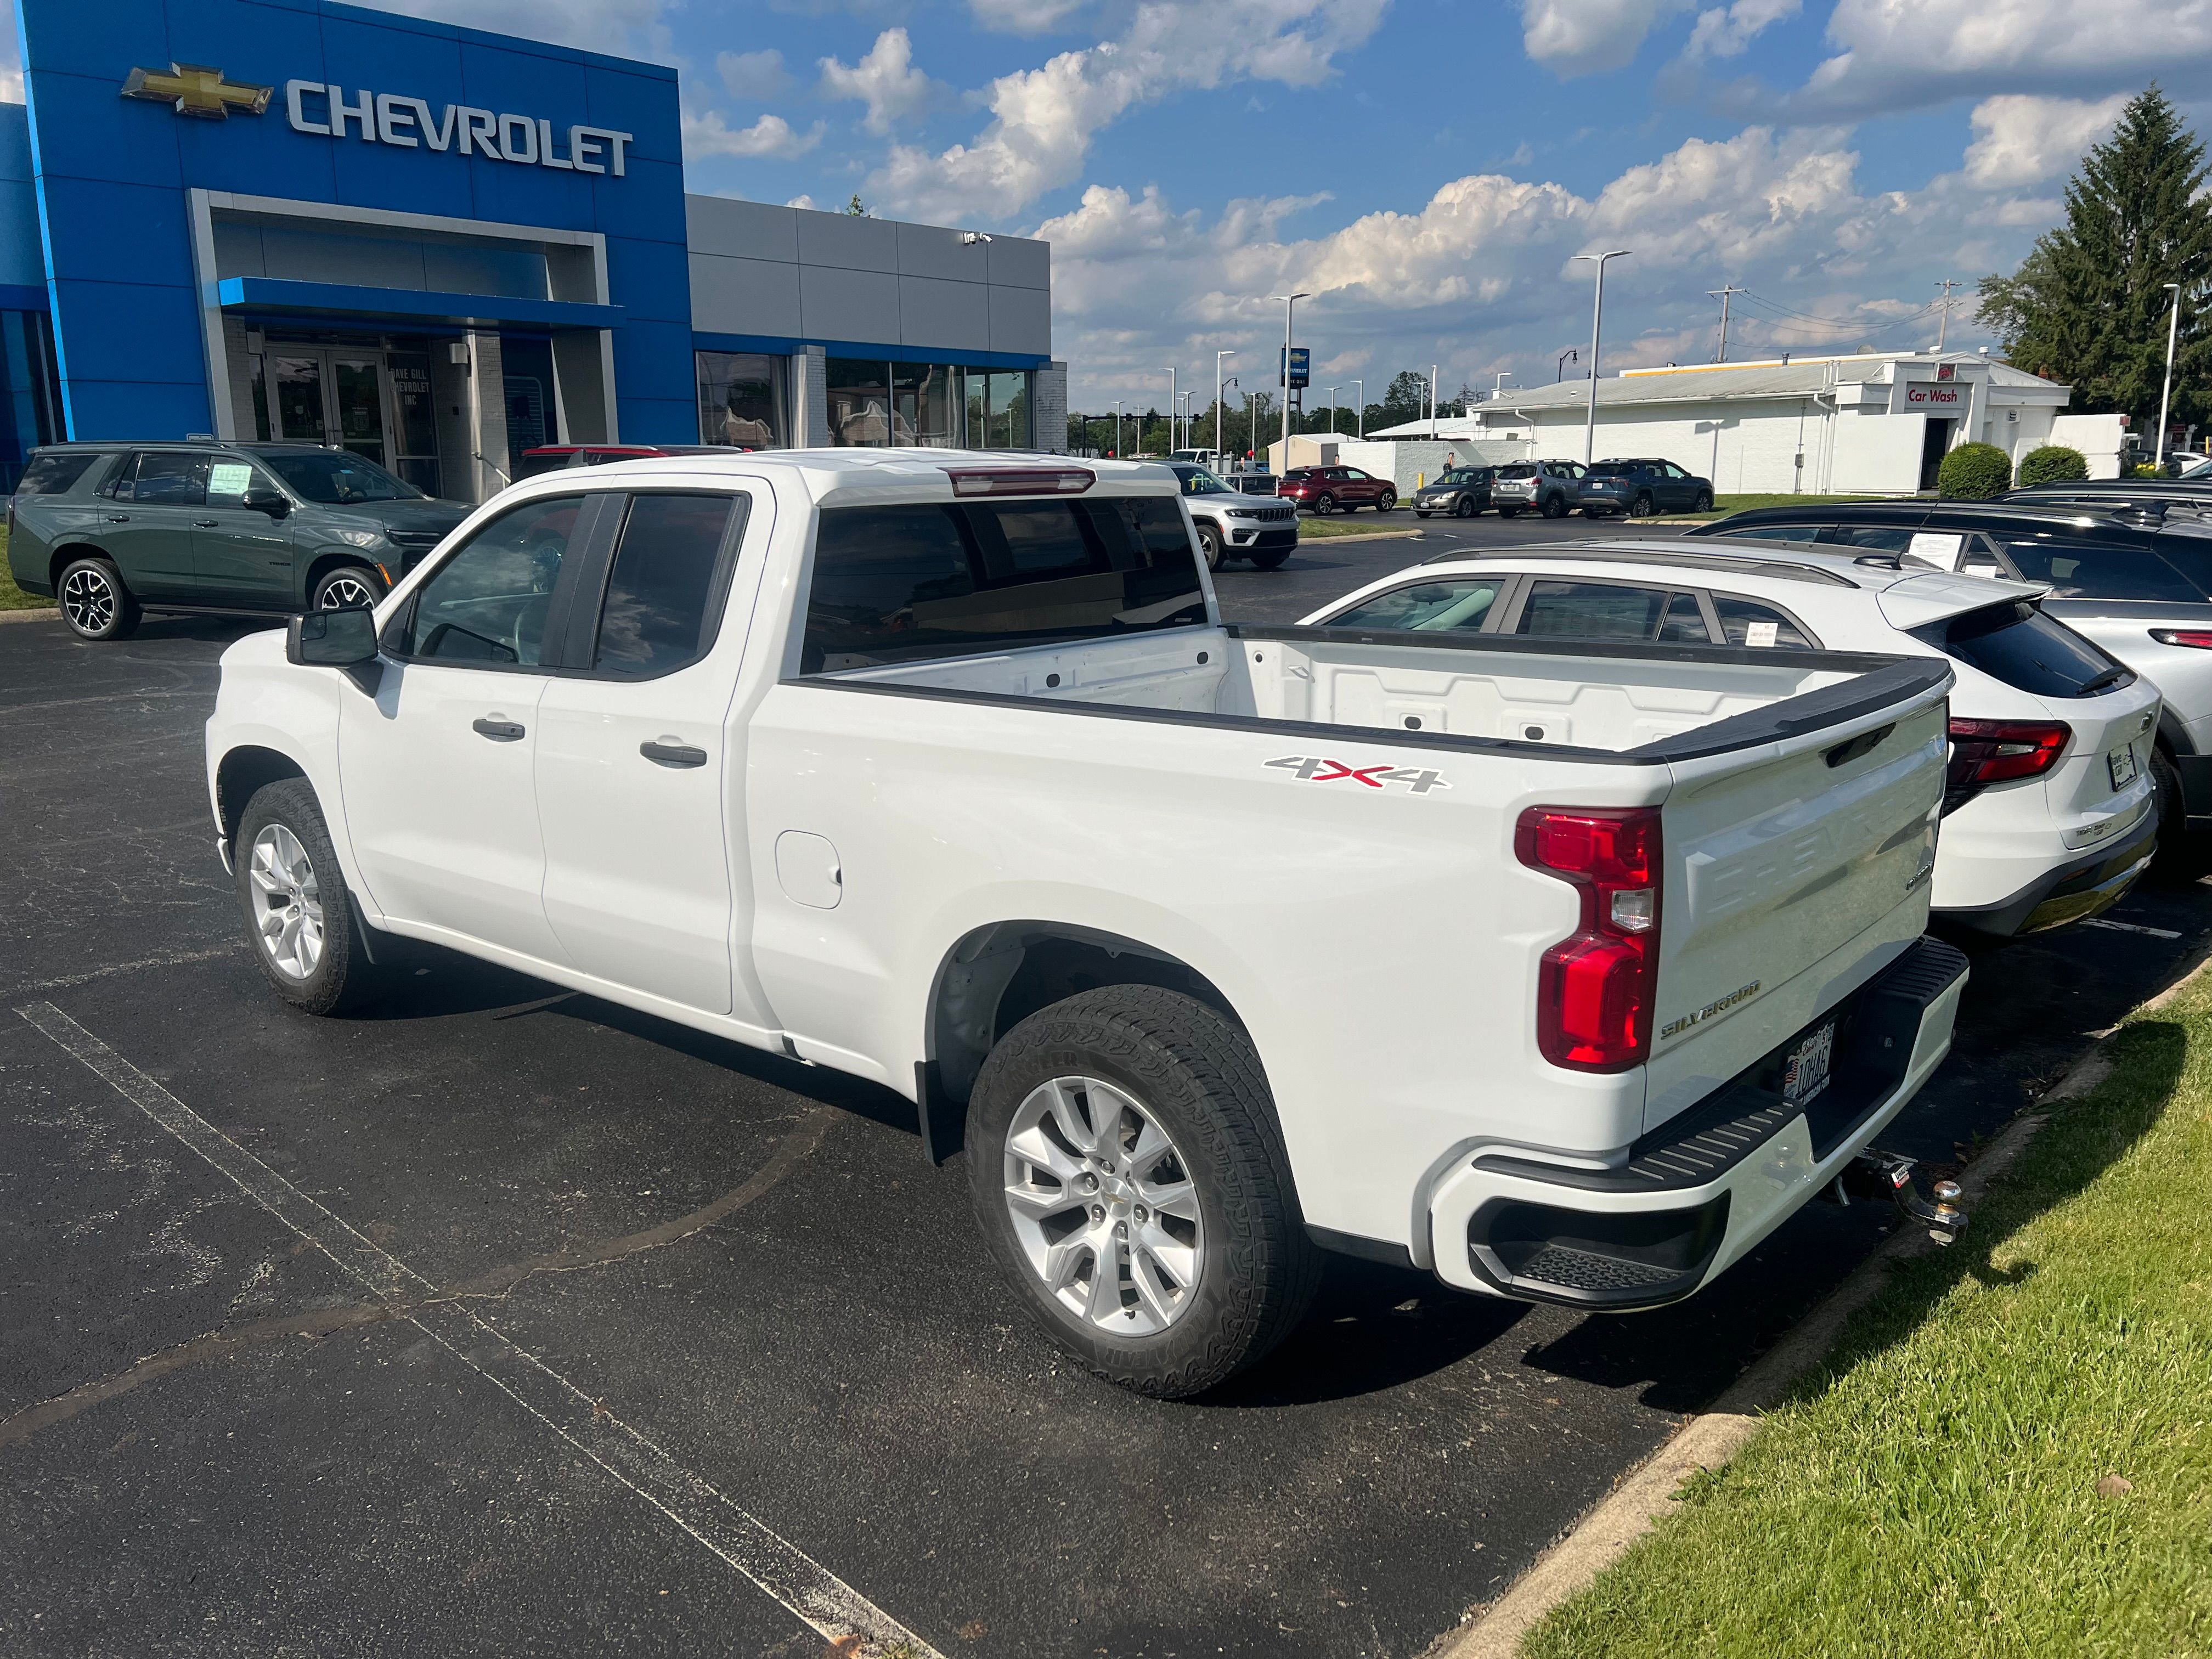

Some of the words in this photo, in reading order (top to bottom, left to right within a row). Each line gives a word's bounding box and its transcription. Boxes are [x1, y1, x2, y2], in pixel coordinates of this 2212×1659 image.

[286, 79, 633, 176] CHEVROLET
[390, 368, 409, 379] DAVE
[411, 369, 426, 380] GILL
[390, 381, 430, 393] CHEVROLET
[405, 394, 416, 405] INC
[1909, 389, 1927, 402] Car
[1930, 388, 1957, 402] Wash
[1661, 979, 1761, 1040] SILVERADO
